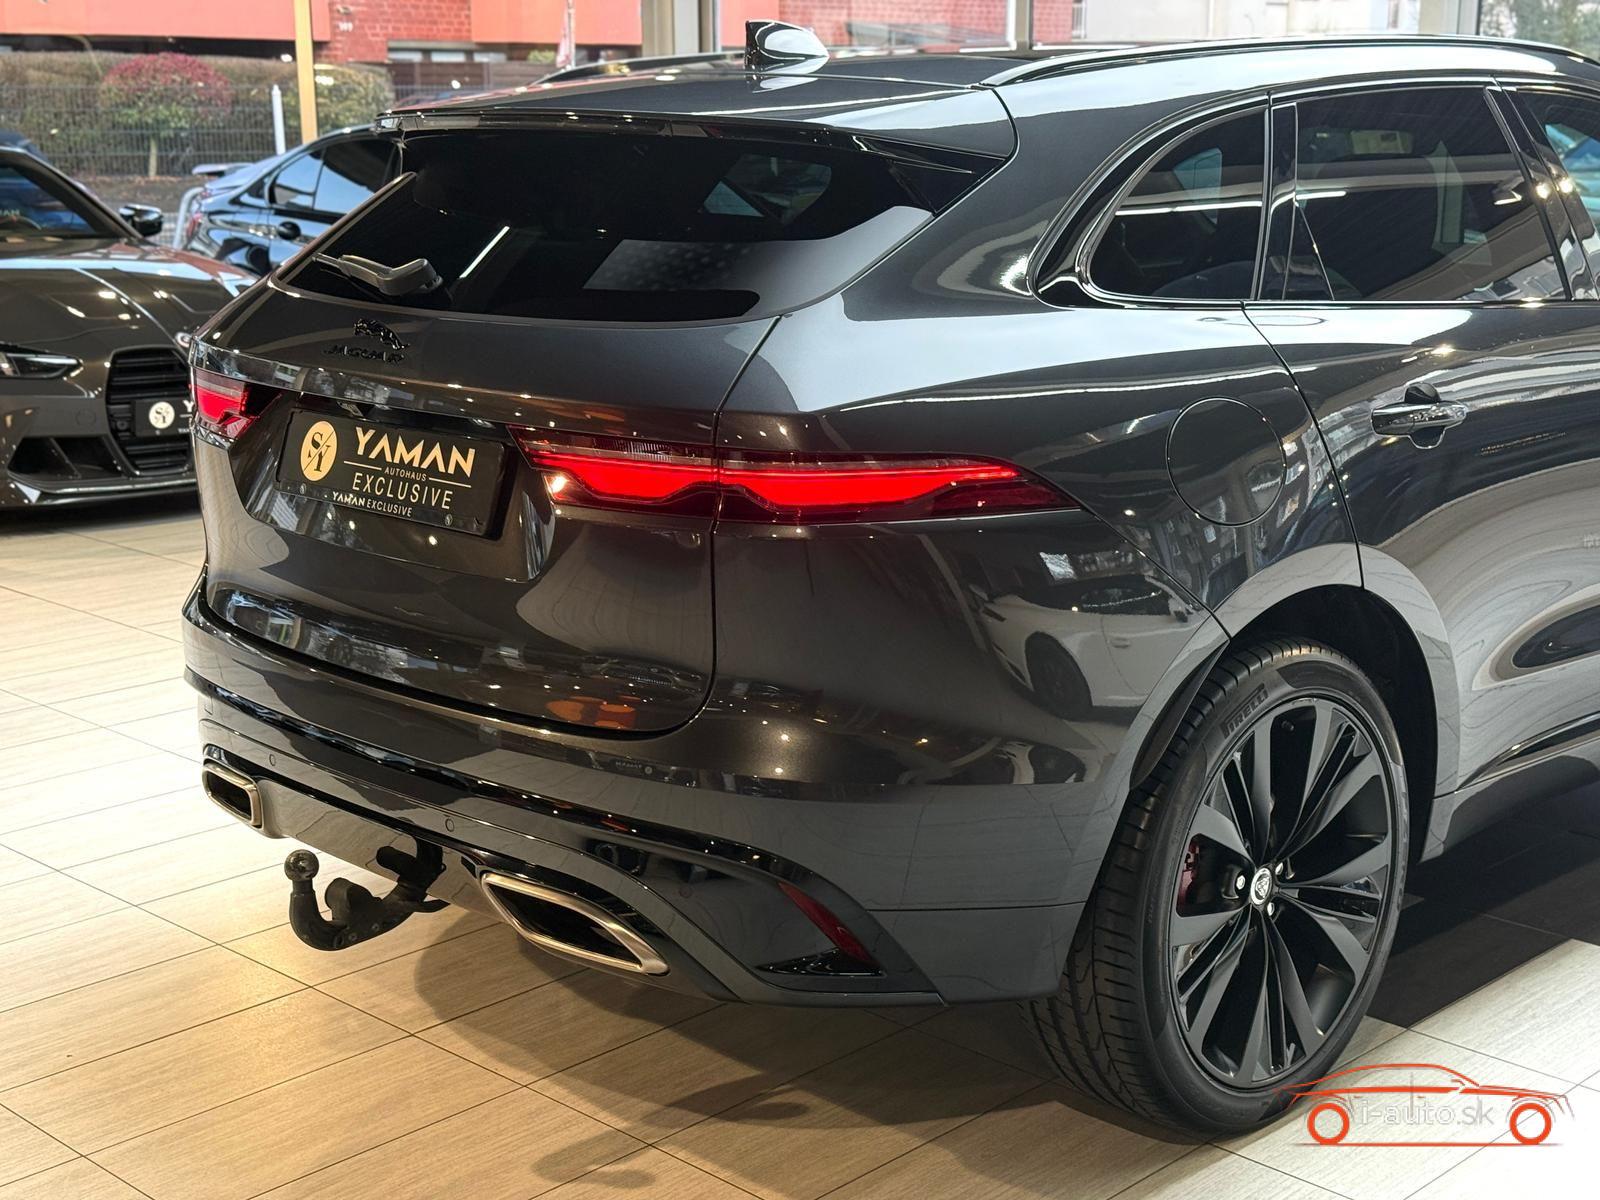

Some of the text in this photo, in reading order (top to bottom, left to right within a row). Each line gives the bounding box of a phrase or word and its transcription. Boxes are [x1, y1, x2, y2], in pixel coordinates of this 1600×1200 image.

[355, 426, 476, 478] YAMAN
[352, 472, 453, 510] EXCLUSIVE
[384, 466, 427, 482] AUTOHAUS
[332, 491, 413, 517] YAMAN EXCLUSIVE
[1220, 682, 1269, 739] PIRELLI
